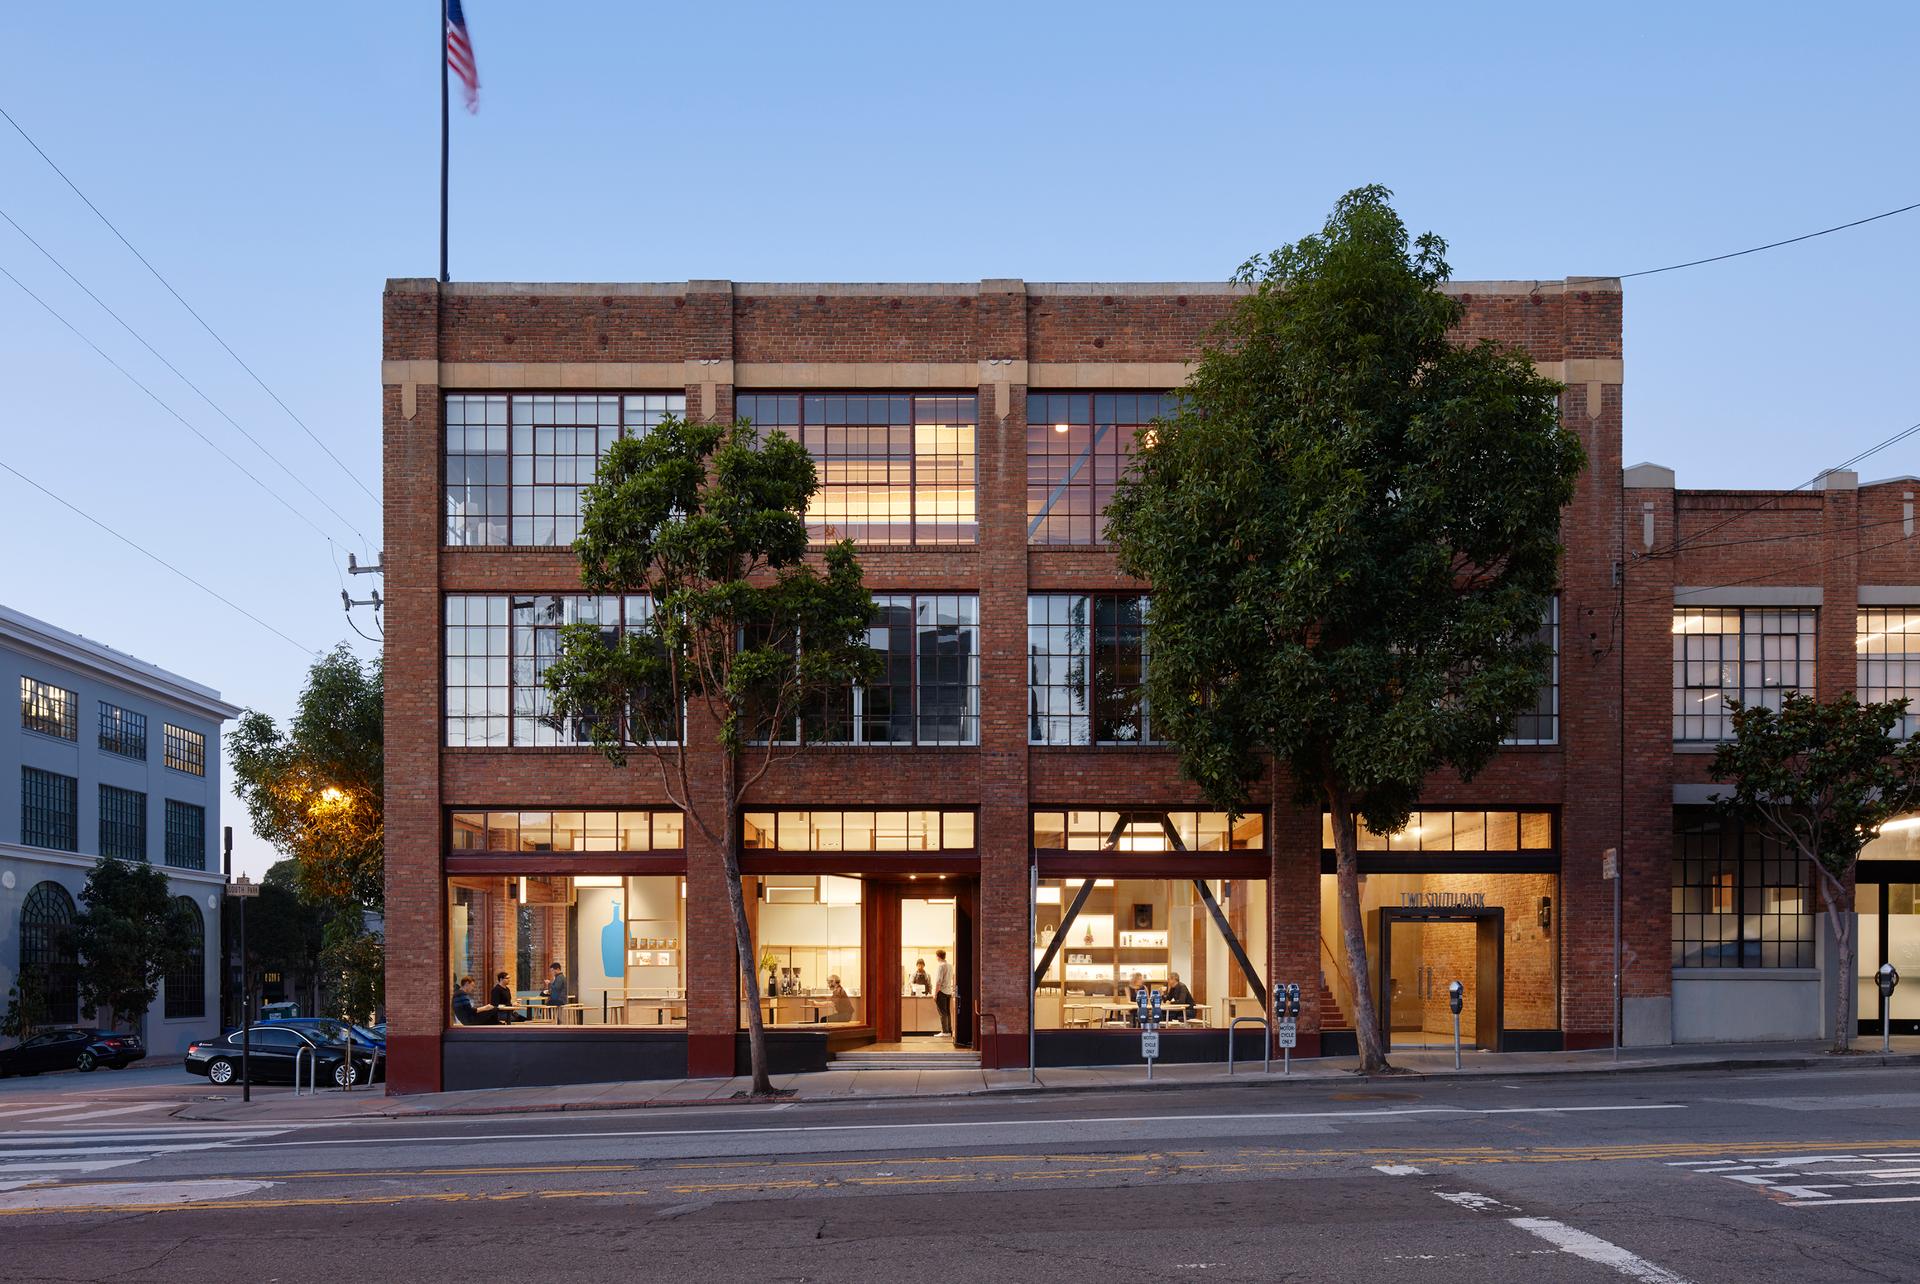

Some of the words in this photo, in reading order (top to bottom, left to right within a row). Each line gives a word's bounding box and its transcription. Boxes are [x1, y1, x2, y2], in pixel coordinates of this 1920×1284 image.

[228, 885, 245, 894] SOUTH
[247, 885, 258, 894] PARK
[1400, 892, 1422, 908] TWO
[1425, 892, 1457, 908] SOUTH
[1460, 892, 1485, 908] PARK
